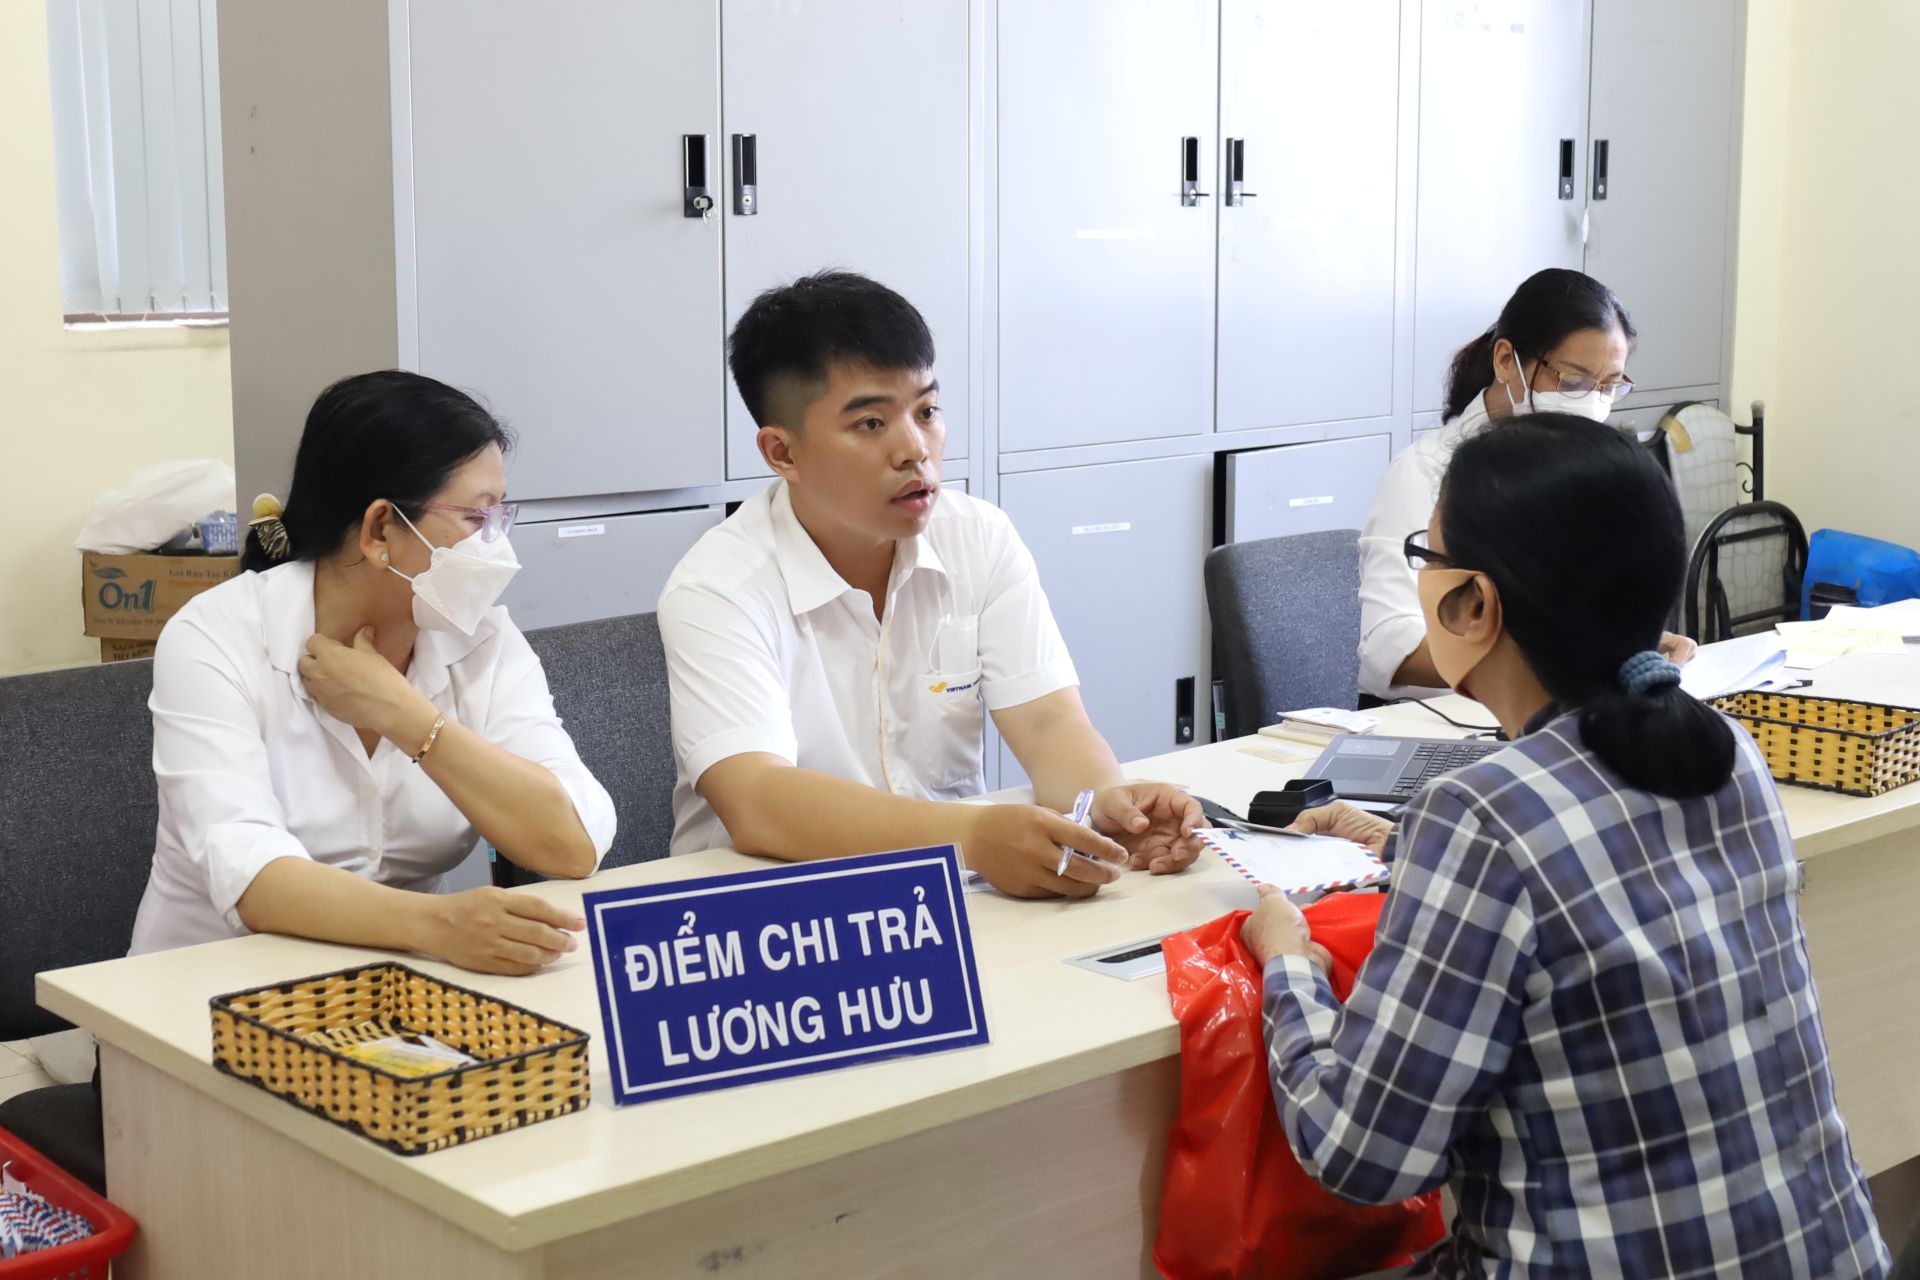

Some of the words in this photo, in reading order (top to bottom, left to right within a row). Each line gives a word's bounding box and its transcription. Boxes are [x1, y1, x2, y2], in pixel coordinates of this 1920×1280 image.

[624, 910, 745, 992] ĐIỂM
[758, 917, 839, 971] CHI
[848, 885, 943, 956] TRẢ
[658, 996, 826, 1067] LƯƠNG
[838, 976, 933, 1036] HƯU
